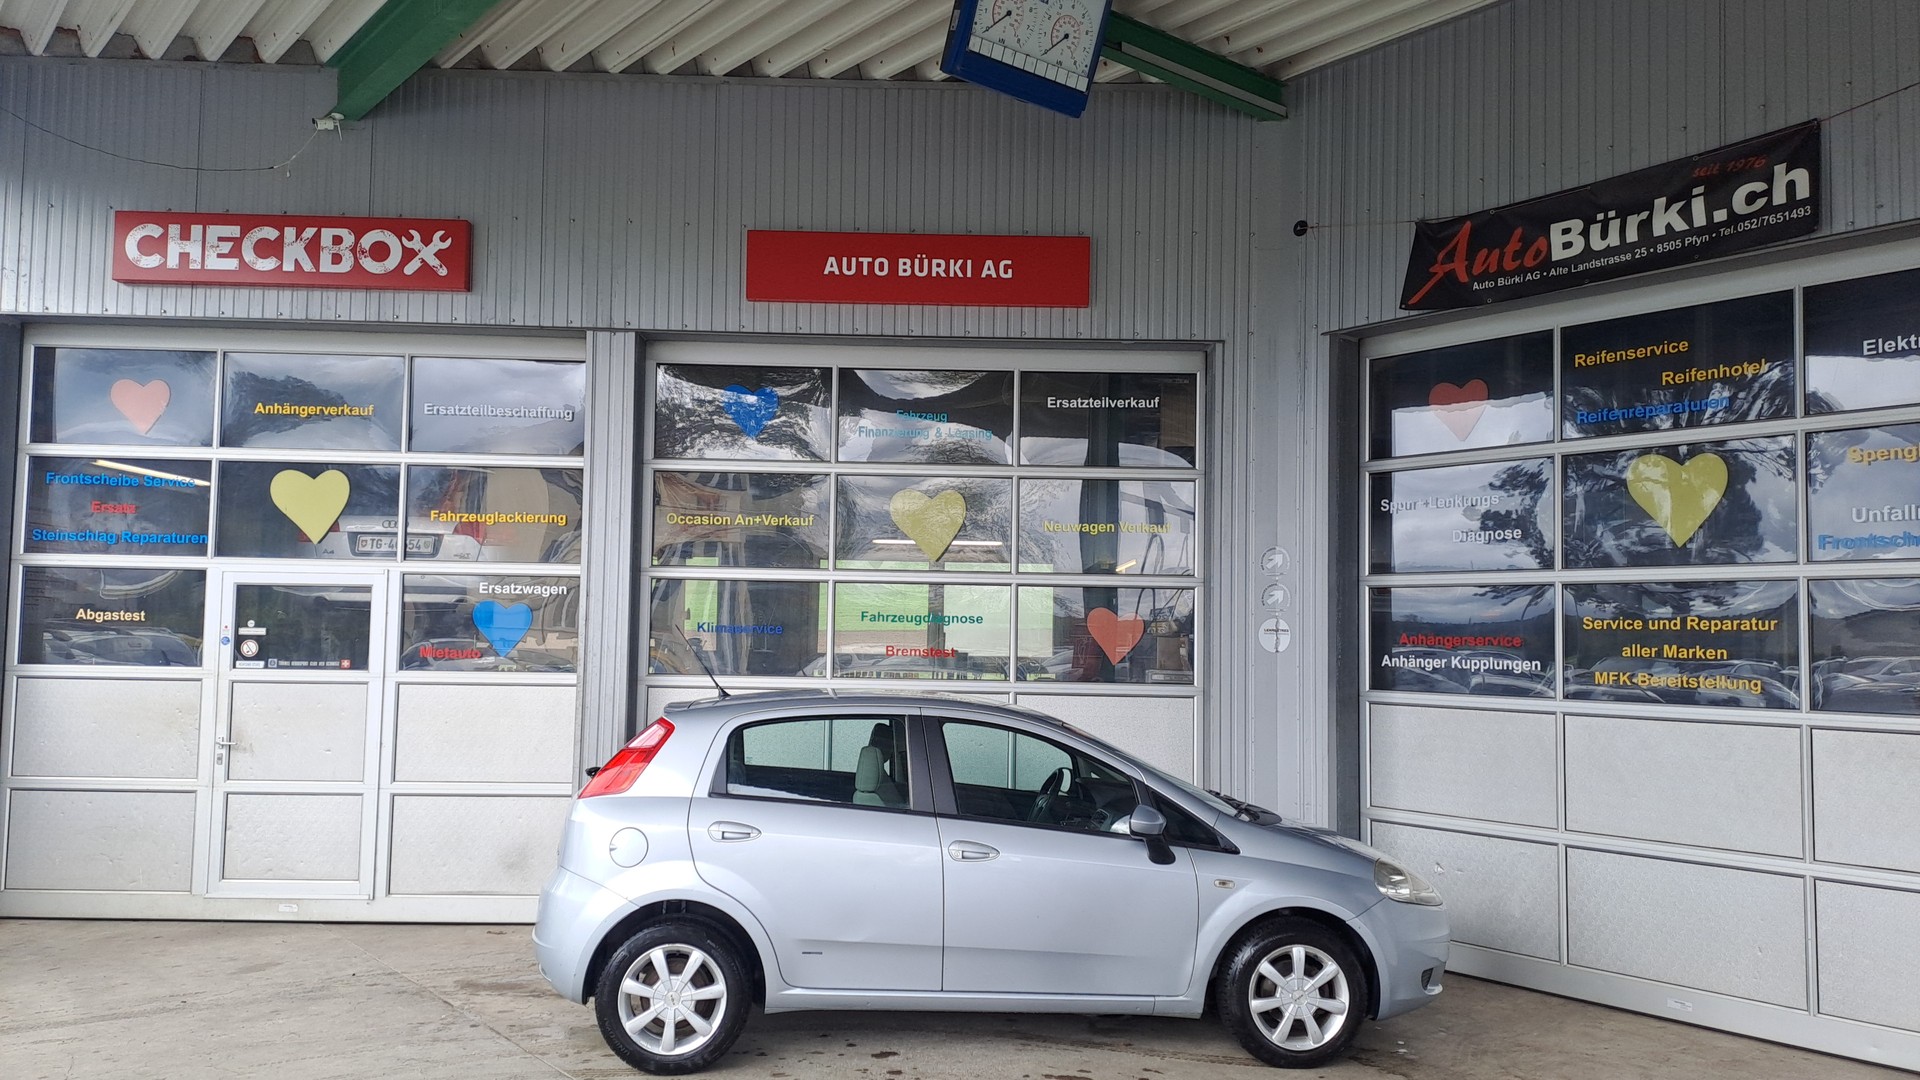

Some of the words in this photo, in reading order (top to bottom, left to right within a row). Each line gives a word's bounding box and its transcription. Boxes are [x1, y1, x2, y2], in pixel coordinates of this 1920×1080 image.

[1726, 154, 1769, 172] 1976
[124, 223, 453, 277] CHECKBOX
[823, 256, 890, 277] AUTO
[898, 254, 973, 278] BÜRKI
[980, 260, 1014, 279] AG
[1472, 281, 1496, 291] Auto
[1496, 274, 1524, 286] Bürki
[1525, 270, 1541, 281] AG
[1548, 265, 1569, 277] Alte
[1570, 251, 1631, 273] Landstrasse
[1634, 248, 1648, 260] 25
[1656, 240, 1683, 254] 8505
[1684, 233, 1710, 249] Pfyn
[1573, 340, 1690, 368] Reifenservice
[1660, 358, 1767, 386] Reifenhotel
[253, 401, 375, 418] Anhängerverkauf
[1046, 396, 1160, 409] Ersatzteilverkauf
[1576, 395, 1731, 425] Reifenreparaturen
[423, 402, 575, 422] Ersatzteilbeschaffung
[895, 409, 949, 424] Fahrzeug
[45, 472, 139, 487] Frontscheibe
[143, 475, 196, 488] Service
[90, 501, 137, 514] Ersatz
[430, 510, 568, 526] Fahrzeuglackierung
[666, 513, 732, 525] Occasion
[734, 514, 815, 527] An+Verkauf
[1042, 521, 1116, 534] Neuwagen
[32, 530, 117, 546] Steinschlag
[121, 531, 209, 546] Reparaturen
[1452, 529, 1523, 545] Diagnose
[479, 583, 568, 597] Ersatzwagen
[75, 608, 147, 623] Abgastest
[860, 611, 984, 625] Fahrzeugdiagnose
[696, 622, 783, 635] Klimaservice
[1583, 616, 1643, 631] Service
[1648, 617, 1681, 630] und
[1686, 617, 1778, 633] Reparatur
[1398, 633, 1524, 650] Anhängerservice
[419, 646, 482, 659] Mietauto
[885, 645, 956, 658] Bremstest
[1621, 645, 1658, 658] aller
[1663, 645, 1728, 660] Marken
[1381, 654, 1447, 669] Anhänger
[1451, 655, 1542, 673] Kupplungen
